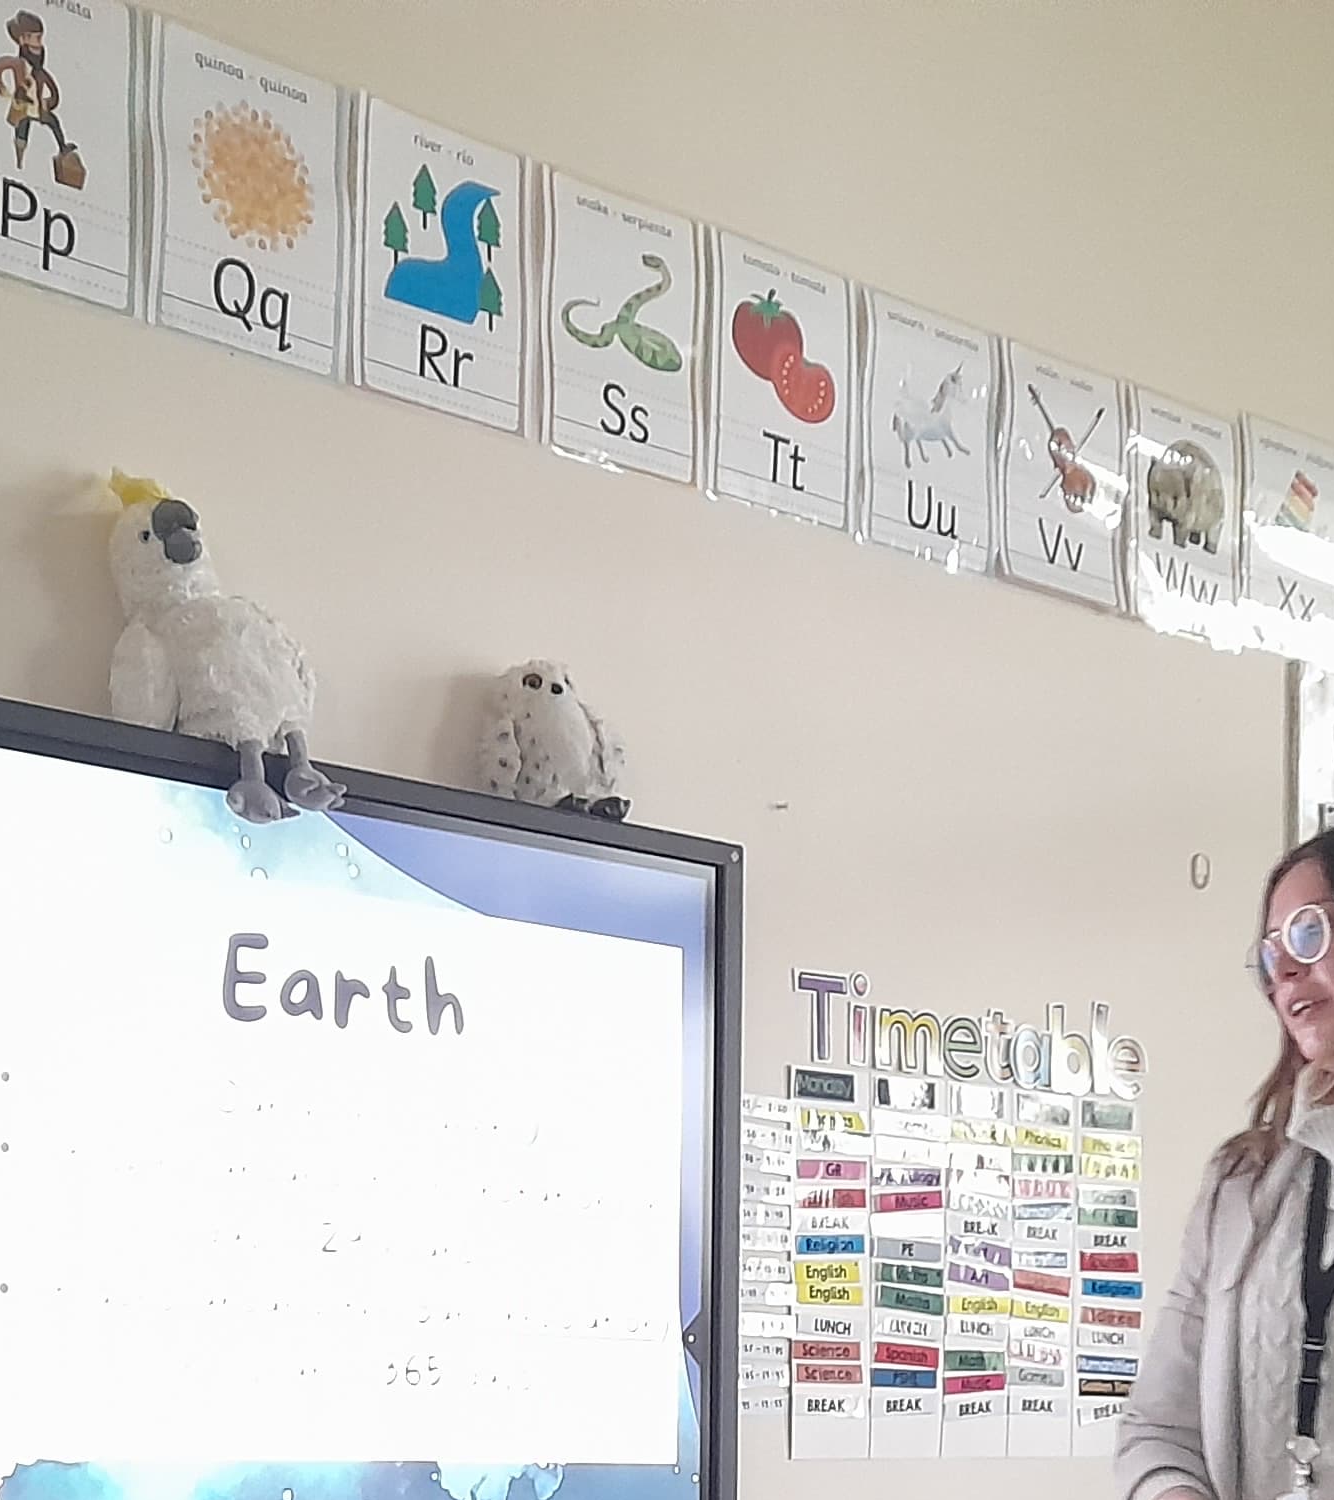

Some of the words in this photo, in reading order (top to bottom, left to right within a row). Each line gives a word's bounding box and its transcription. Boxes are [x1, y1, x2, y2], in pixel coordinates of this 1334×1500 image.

[194, 52, 244, 80] quinoa
[260, 76, 308, 104] quinoa
[414, 133, 441, 153] river
[0, 177, 75, 270] Pp
[213, 257, 292, 354] Qq
[419, 325, 473, 388] Rr
[601, 383, 650, 444] Ss
[763, 431, 806, 492] Tt
[906, 479, 958, 539] Uu
[1039, 517, 1085, 572] Vv
[1156, 552, 1218, 606] Ww
[1277, 576, 1314, 621] Xx
[222, 933, 464, 1035] Earth
[795, 970, 1145, 1097] Timetable
[797, 1075, 851, 1096] Monday
[1027, 1226, 1057, 1240] BREAK
[1094, 1235, 1127, 1247] BREAK
[806, 1239, 854, 1254] Religion
[806, 1265, 847, 1281] English
[809, 1286, 850, 1302] English
[961, 1298, 997, 1314] English
[1025, 1302, 1059, 1318] English
[815, 1318, 851, 1335] LUNCH
[802, 1343, 850, 1357] Science
[805, 1367, 852, 1380] Science
[807, 1399, 845, 1412] BREAK
[886, 1398, 922, 1412] BREAK
[959, 1400, 992, 1416] BREAK
[1022, 1399, 1053, 1412] BREAK
[1094, 1404, 1124, 1419] BREA
